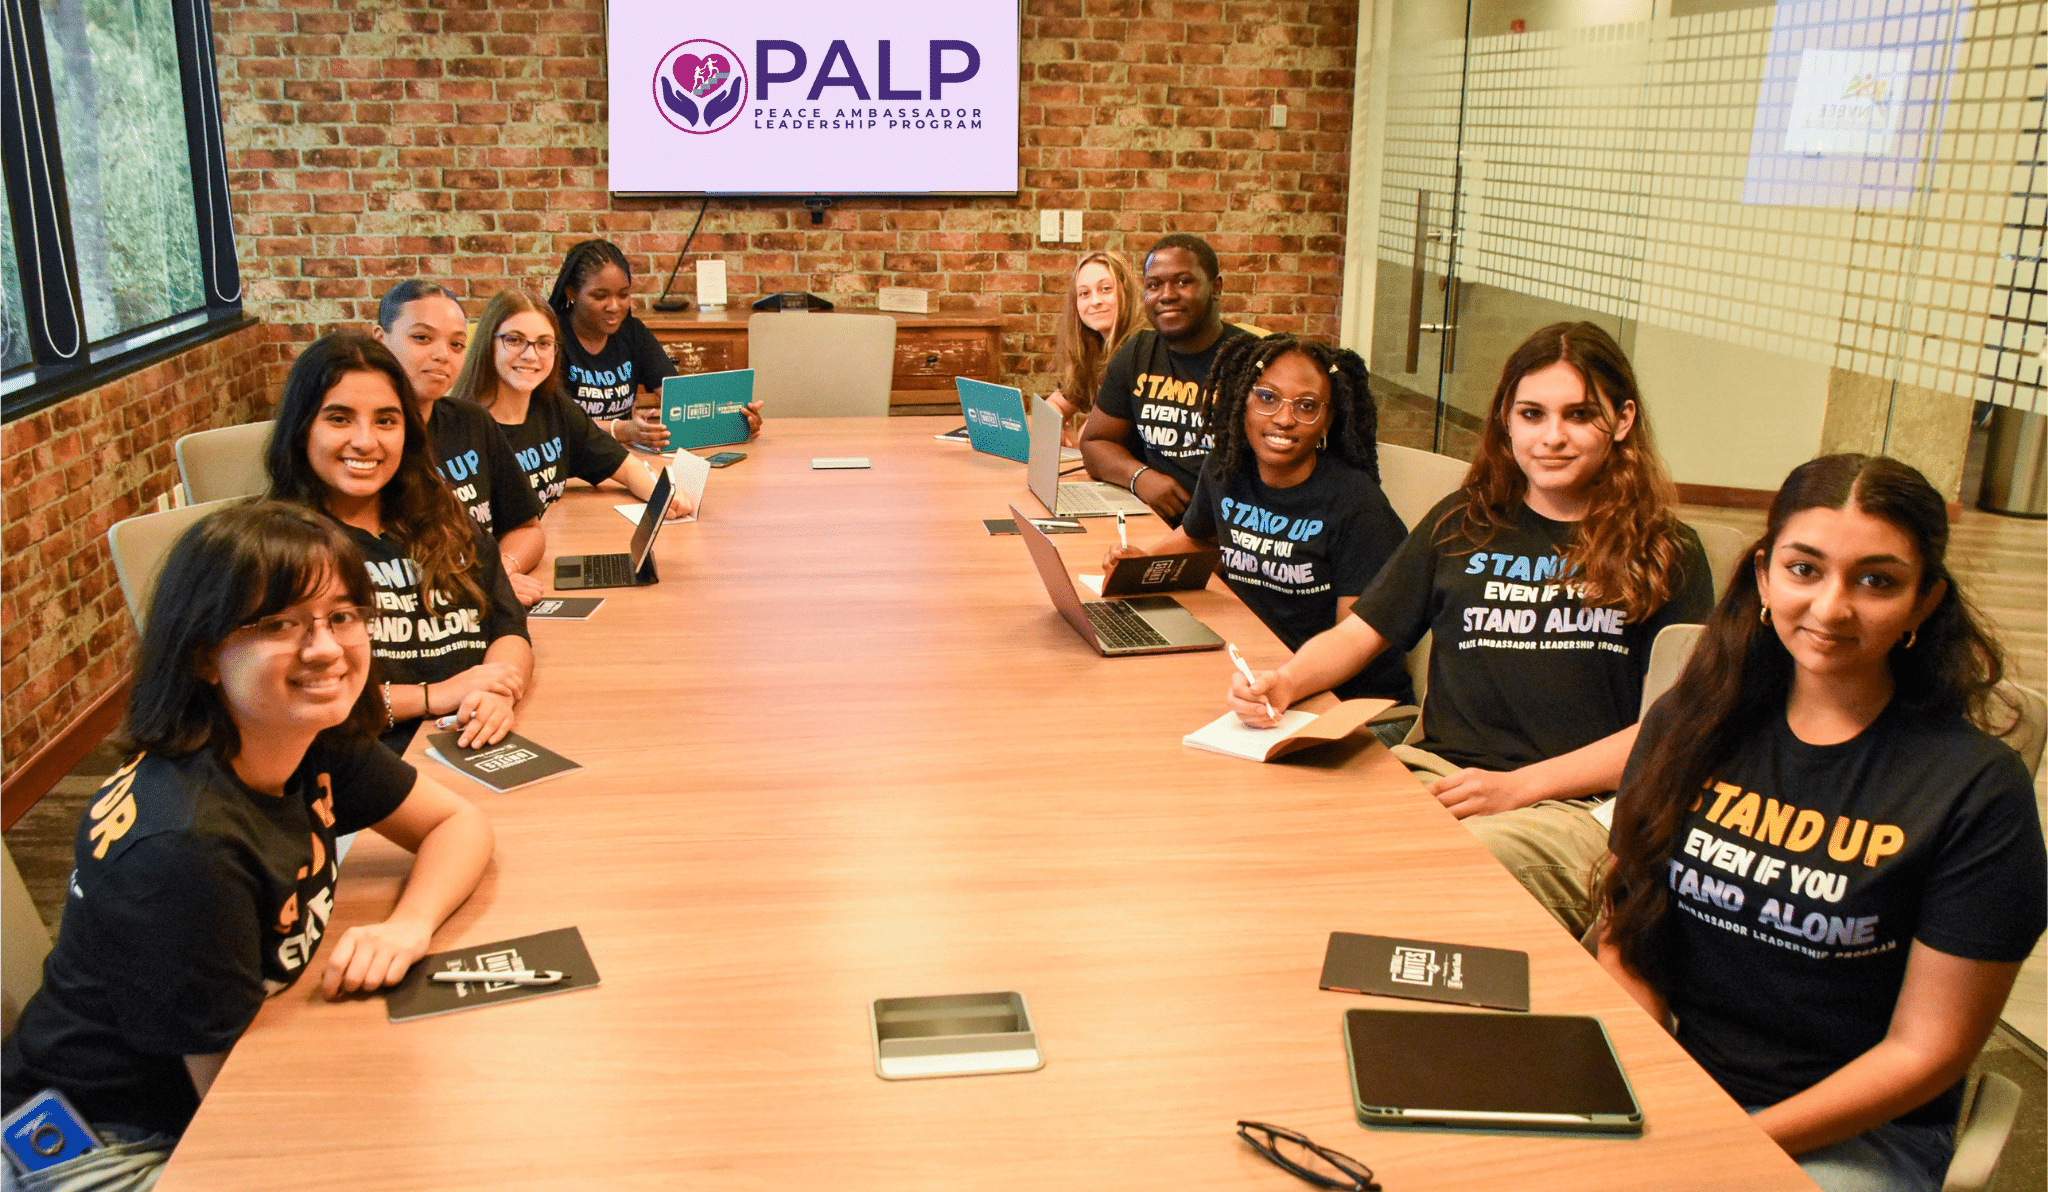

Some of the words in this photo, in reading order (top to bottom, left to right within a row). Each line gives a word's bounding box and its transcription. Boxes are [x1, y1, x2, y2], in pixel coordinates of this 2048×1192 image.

[755, 38, 981, 101] PALP
[754, 108, 822, 118] PEACE
[836, 108, 982, 118] AMBASSADOR
[754, 119, 877, 129] LEADERSHIP
[889, 119, 983, 130] PROGRAM
[569, 365, 617, 387] STAND
[617, 361, 632, 381] UP
[577, 386, 604, 399] EVEN
[573, 398, 605, 415] AND
[1140, 404, 1181, 423] EVEN
[1136, 424, 1179, 447] TAND
[541, 436, 563, 463] UP
[446, 449, 479, 481] UP
[529, 473, 540, 489] IF
[1221, 497, 1289, 534] STAND
[1287, 519, 1324, 542] UP
[1230, 529, 1263, 552] EVEN
[1260, 538, 1274, 555] IF
[1273, 540, 1294, 558] YOU
[1484, 580, 1540, 603] EVEN
[1540, 584, 1561, 602] IF
[1463, 606, 1537, 634] STAND
[1543, 606, 1628, 636] ALONE
[1458, 639, 1477, 651] PEACE
[1477, 637, 1537, 651] AMBASSADOR
[1539, 640, 1596, 650] LEADERSHIP
[1827, 814, 1906, 869] UP
[1683, 827, 1756, 878] EVEN
[1752, 854, 1787, 886] IF
[1789, 863, 1849, 903] YOU
[1668, 858, 1745, 913] TAND
[1757, 897, 1880, 947] ALONE
[1677, 900, 1749, 937] AMBASSADOR
[1752, 928, 1830, 961] LEADERSHIP
